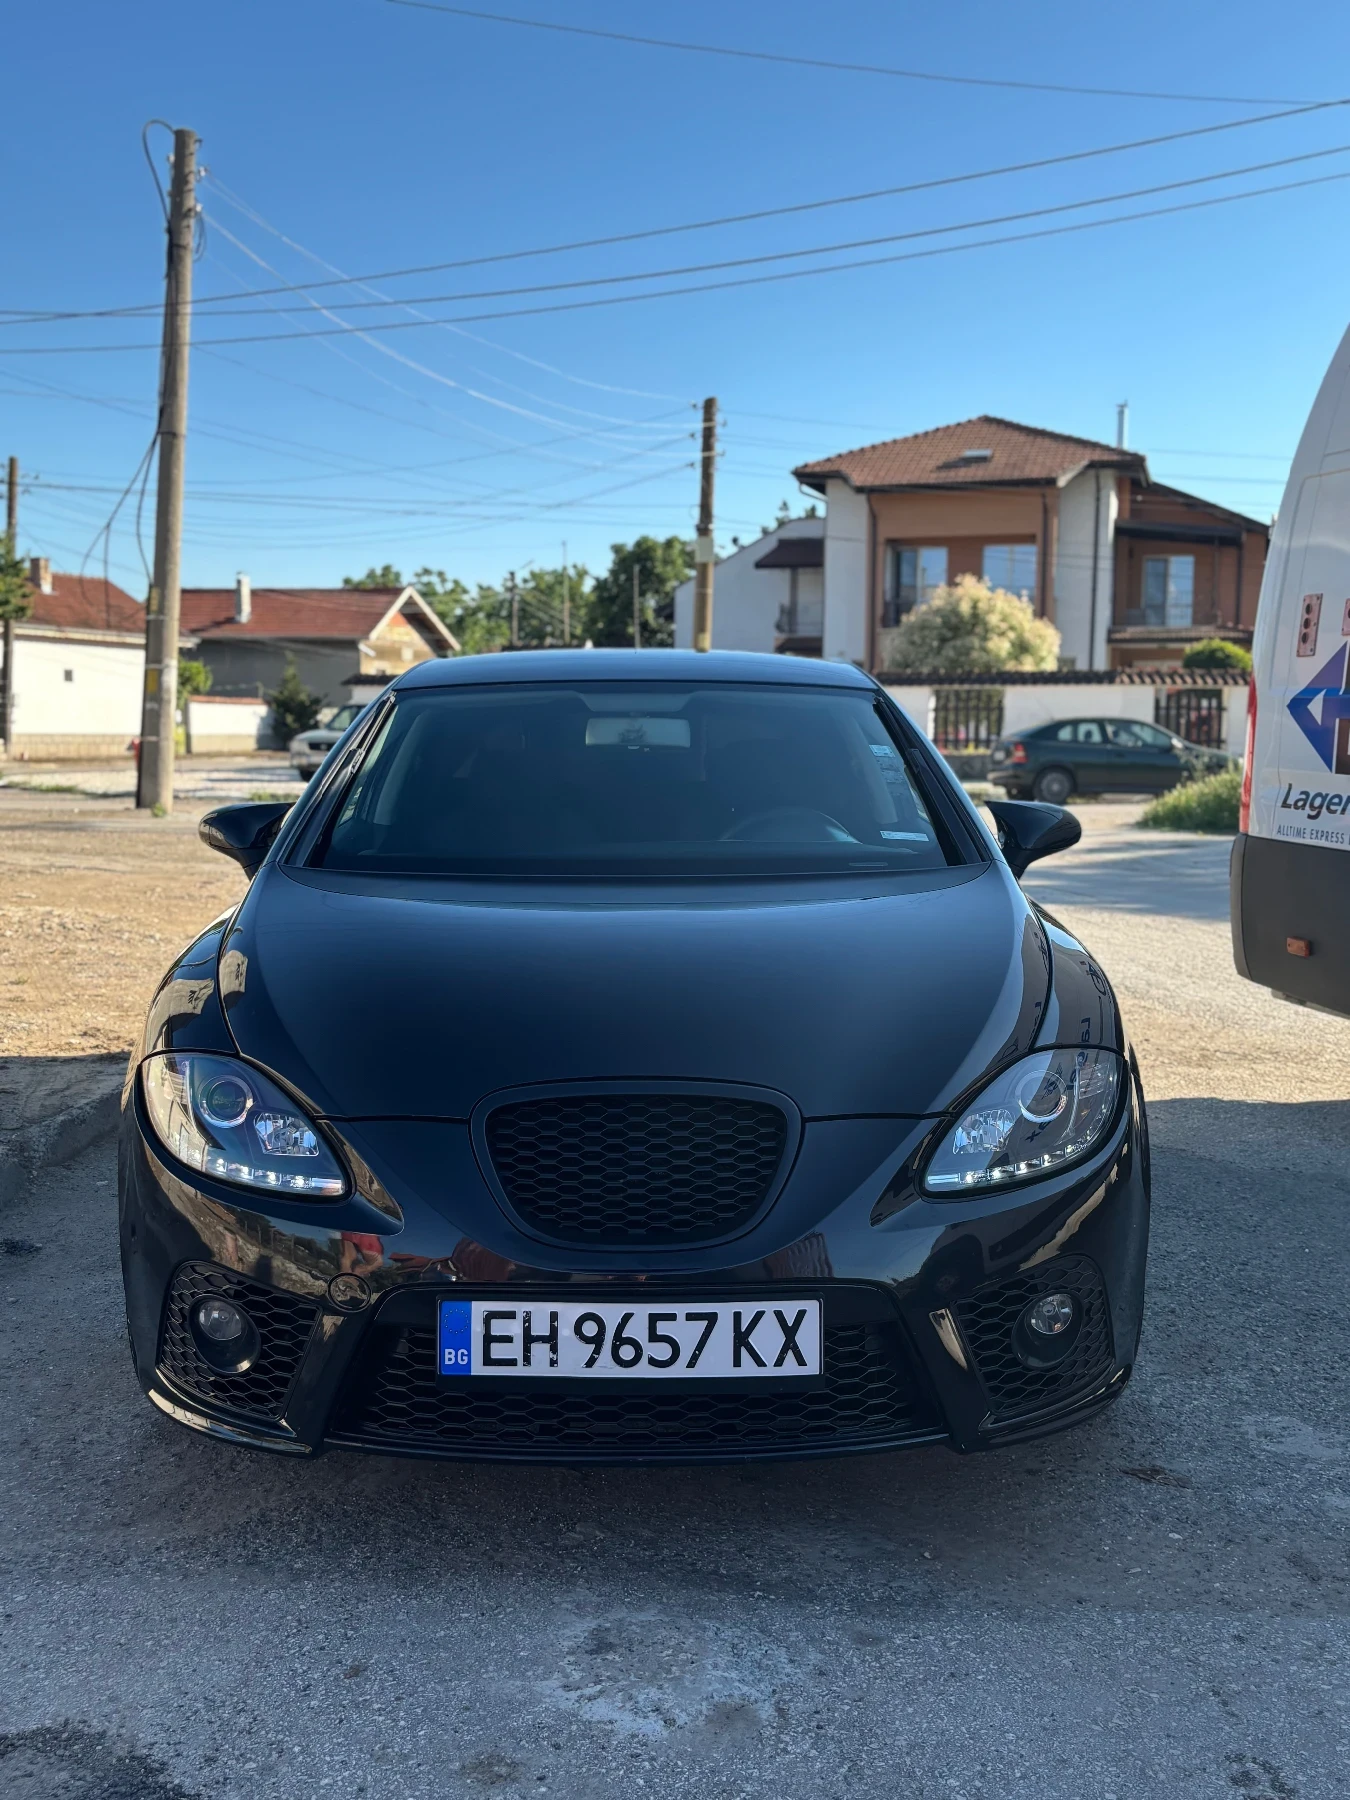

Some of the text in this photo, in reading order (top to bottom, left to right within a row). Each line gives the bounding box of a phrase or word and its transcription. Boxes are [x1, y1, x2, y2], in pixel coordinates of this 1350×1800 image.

[1277, 824, 1307, 838] ALLTIME
[1309, 828, 1345, 844] EXPRESS
[482, 1308, 808, 1369] EH 9657 KX
[444, 1349, 469, 1365] BG
